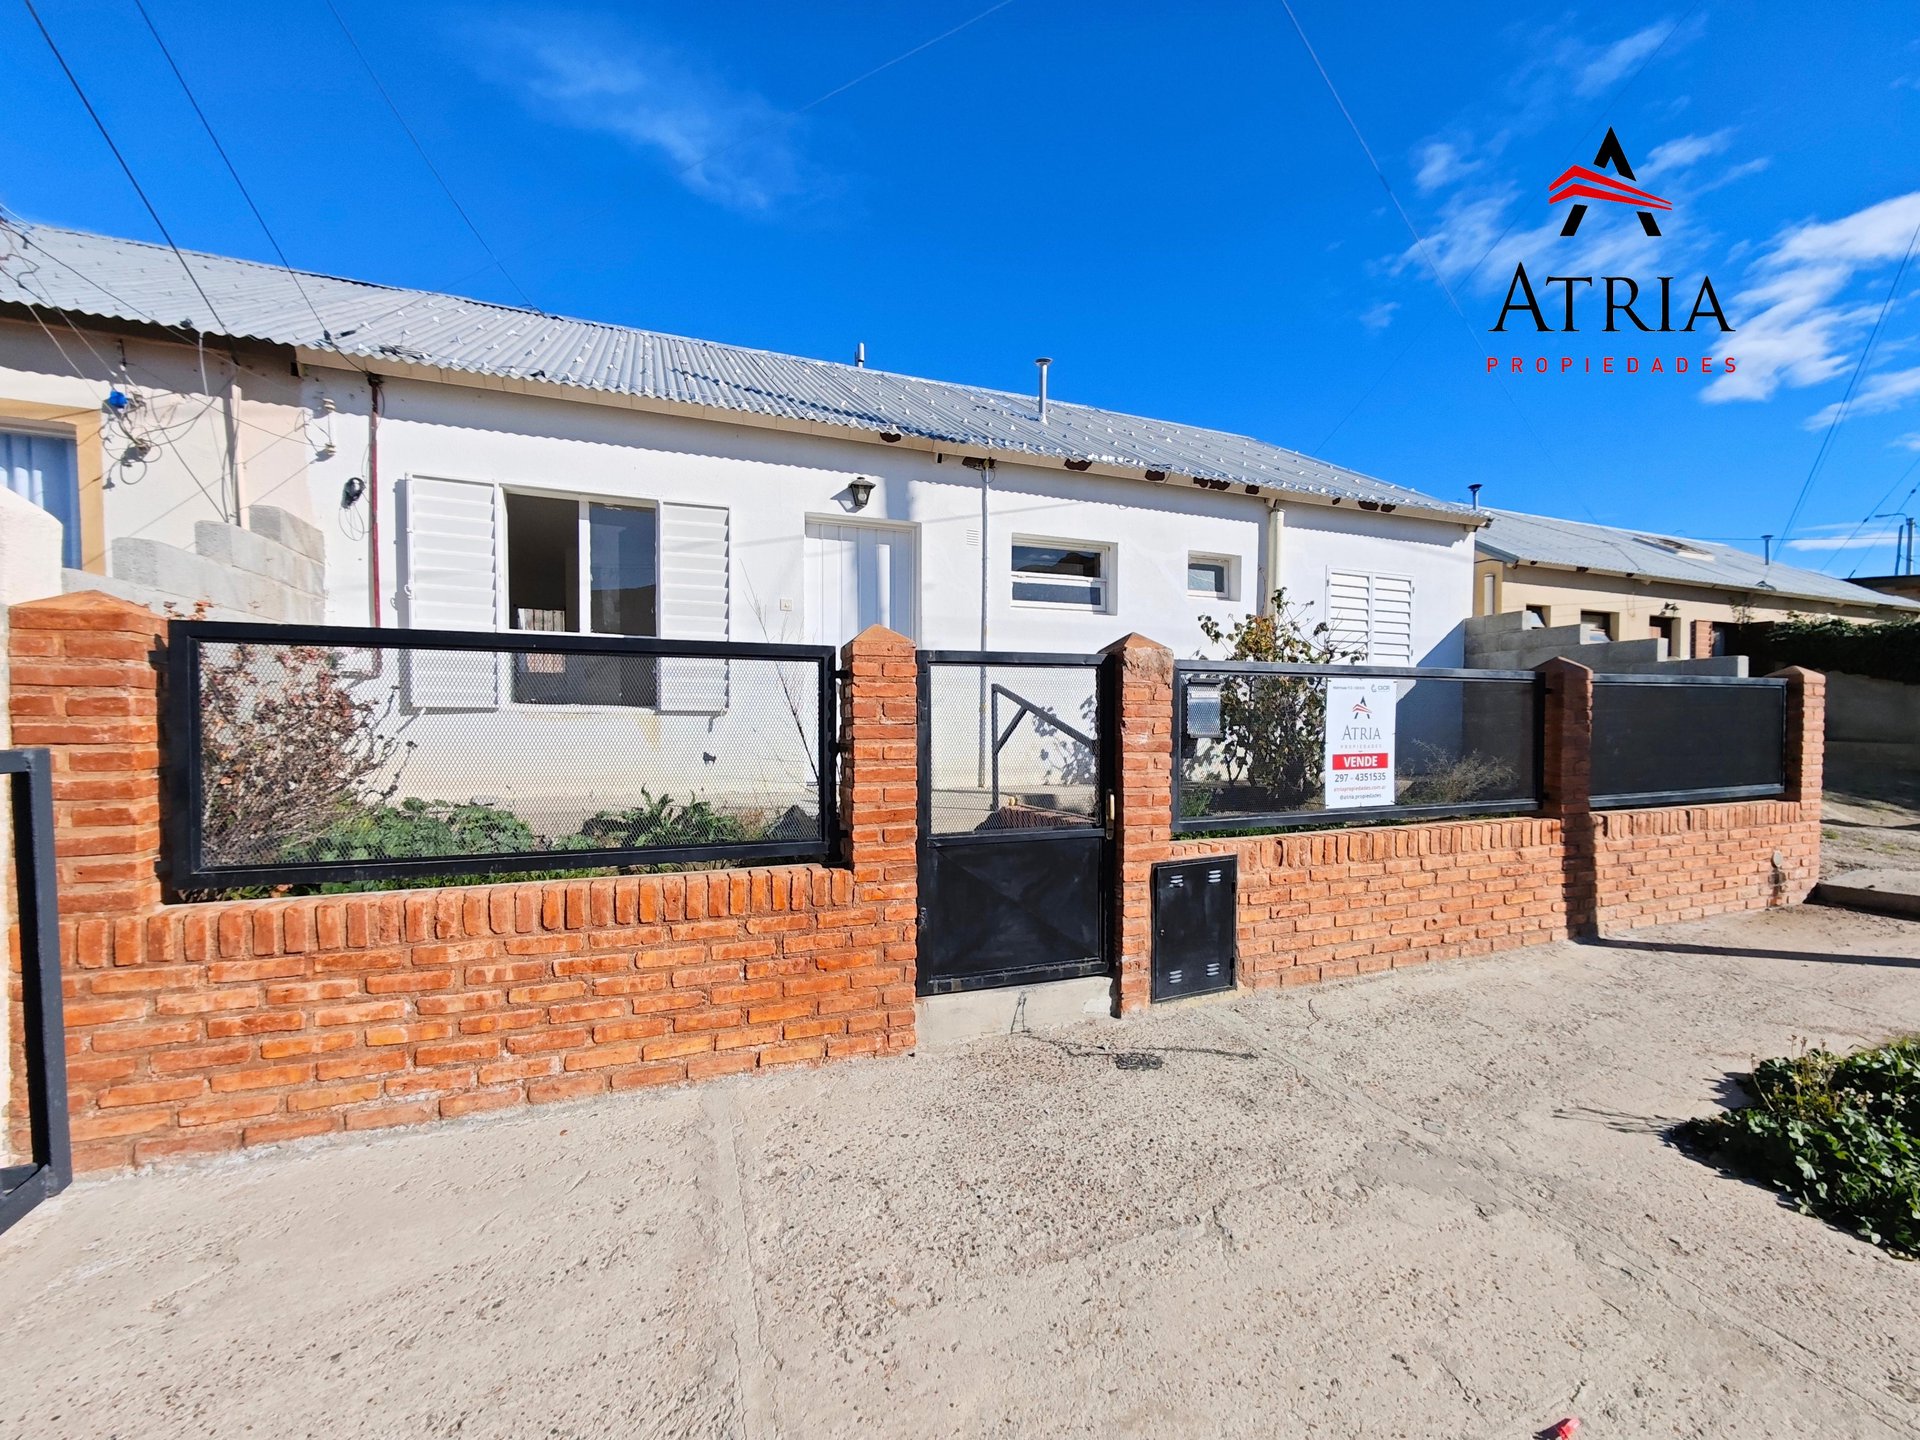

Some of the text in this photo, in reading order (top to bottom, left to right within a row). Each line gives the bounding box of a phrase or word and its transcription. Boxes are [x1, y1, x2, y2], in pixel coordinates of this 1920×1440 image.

[1341, 724, 1381, 741] ATRIA
[1343, 756, 1378, 768] VENDE
[1334, 773, 1349, 783] 297
[1355, 772, 1386, 782] 4351535
